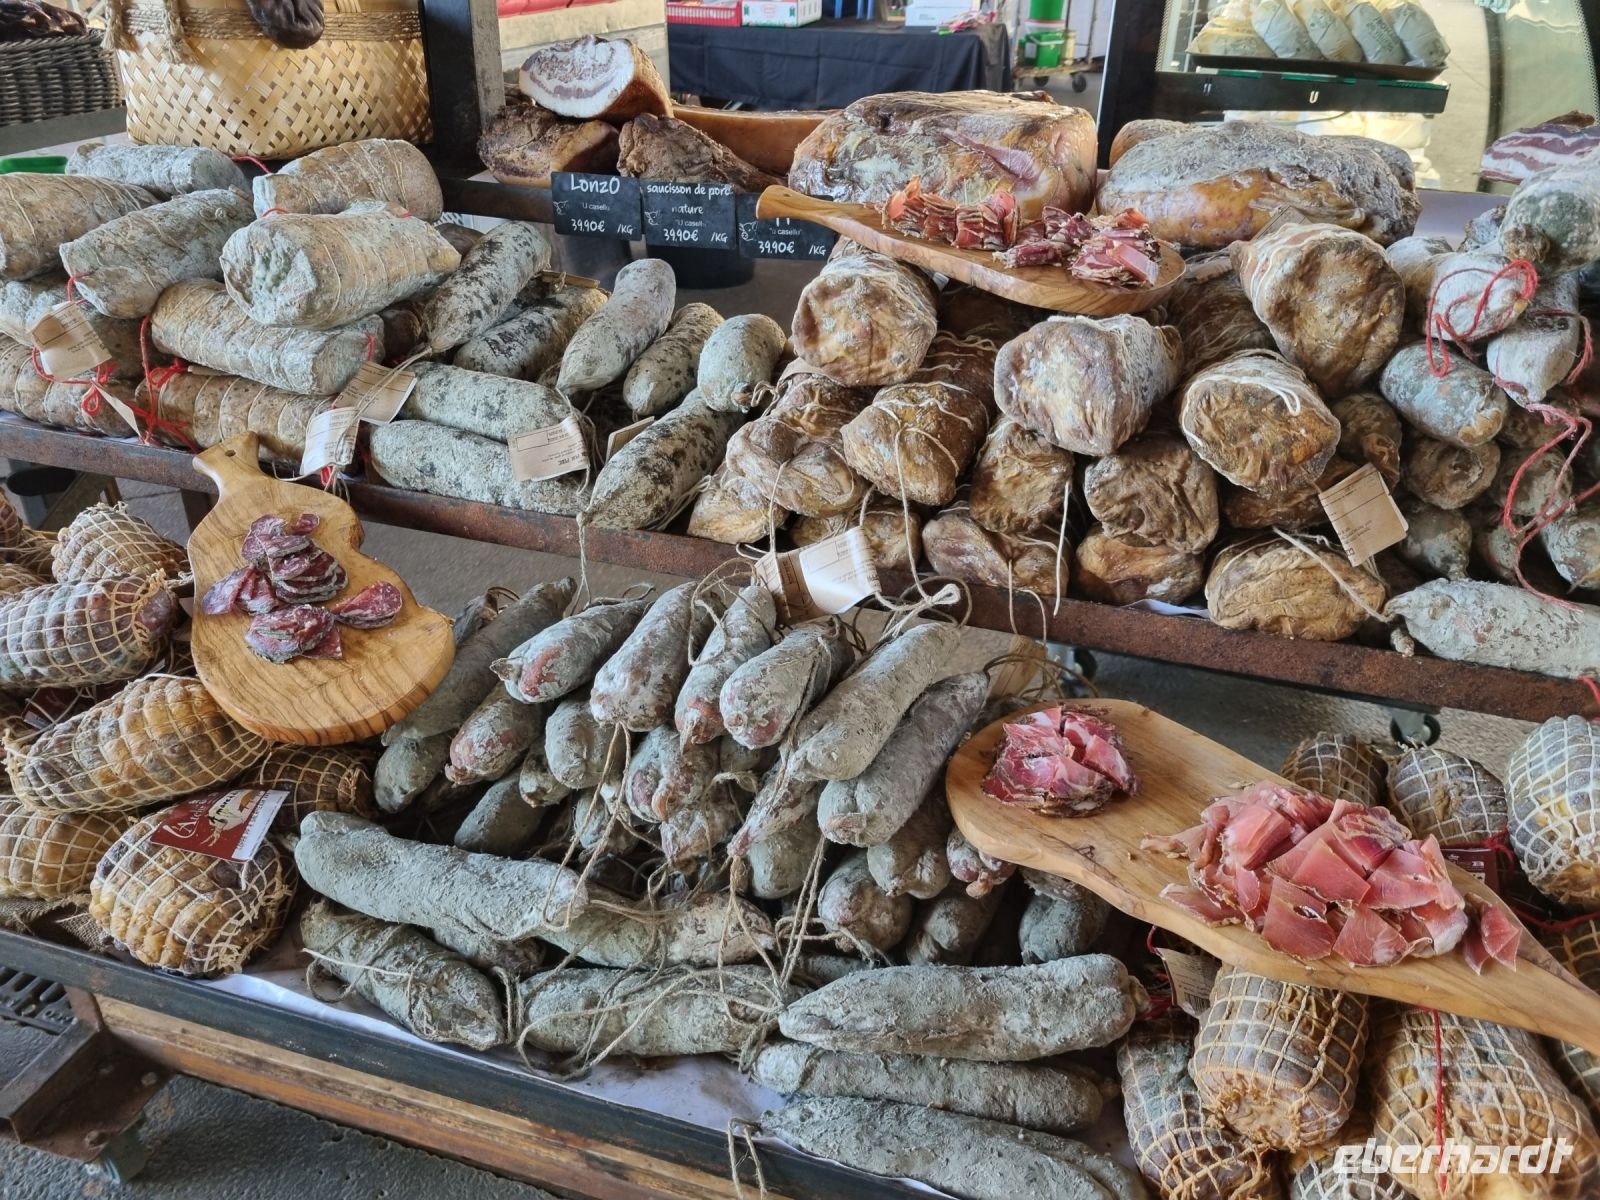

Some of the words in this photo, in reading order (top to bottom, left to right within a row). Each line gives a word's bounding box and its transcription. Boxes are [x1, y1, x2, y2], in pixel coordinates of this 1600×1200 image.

[647, 181, 691, 195] saucisson
[694, 184, 706, 195] de
[671, 204, 704, 215] nature
[617, 223, 633, 235] /KG
[710, 233, 728, 243] /KG
[808, 245, 827, 256] /KG
